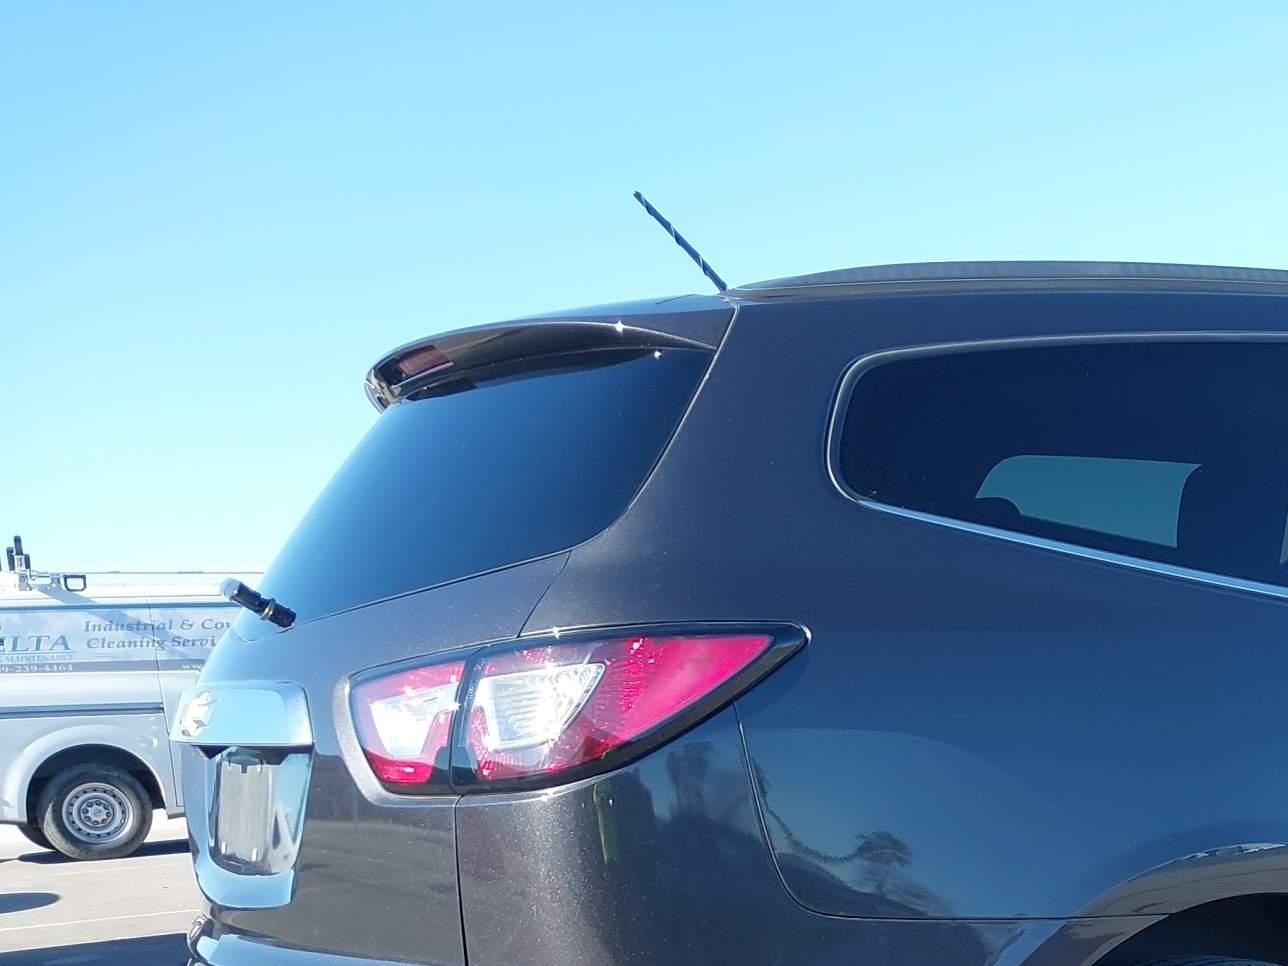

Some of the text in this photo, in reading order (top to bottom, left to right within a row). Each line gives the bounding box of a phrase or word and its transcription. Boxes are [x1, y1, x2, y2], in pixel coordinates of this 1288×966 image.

[84, 620, 173, 632] Industrial
[180, 619, 194, 630] &
[86, 635, 217, 650] Cleaning Servi
